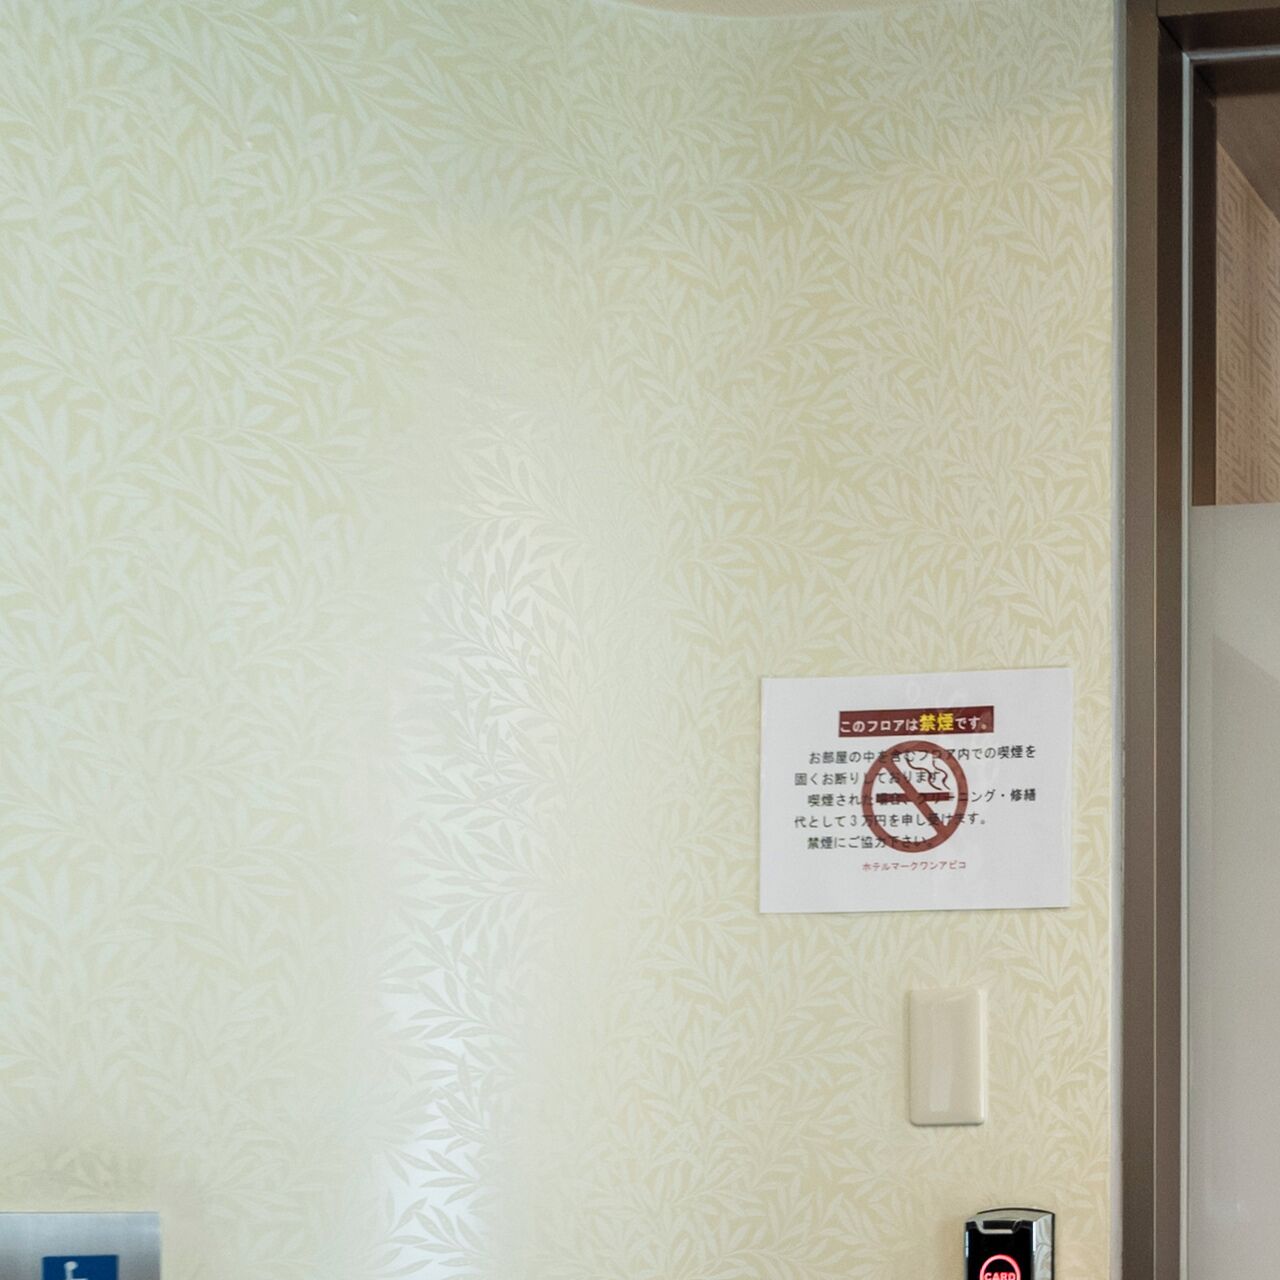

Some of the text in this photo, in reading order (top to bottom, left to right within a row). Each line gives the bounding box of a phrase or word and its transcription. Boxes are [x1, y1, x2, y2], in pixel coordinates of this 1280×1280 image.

[840, 712, 987, 733] このフロアは禁煙です。
